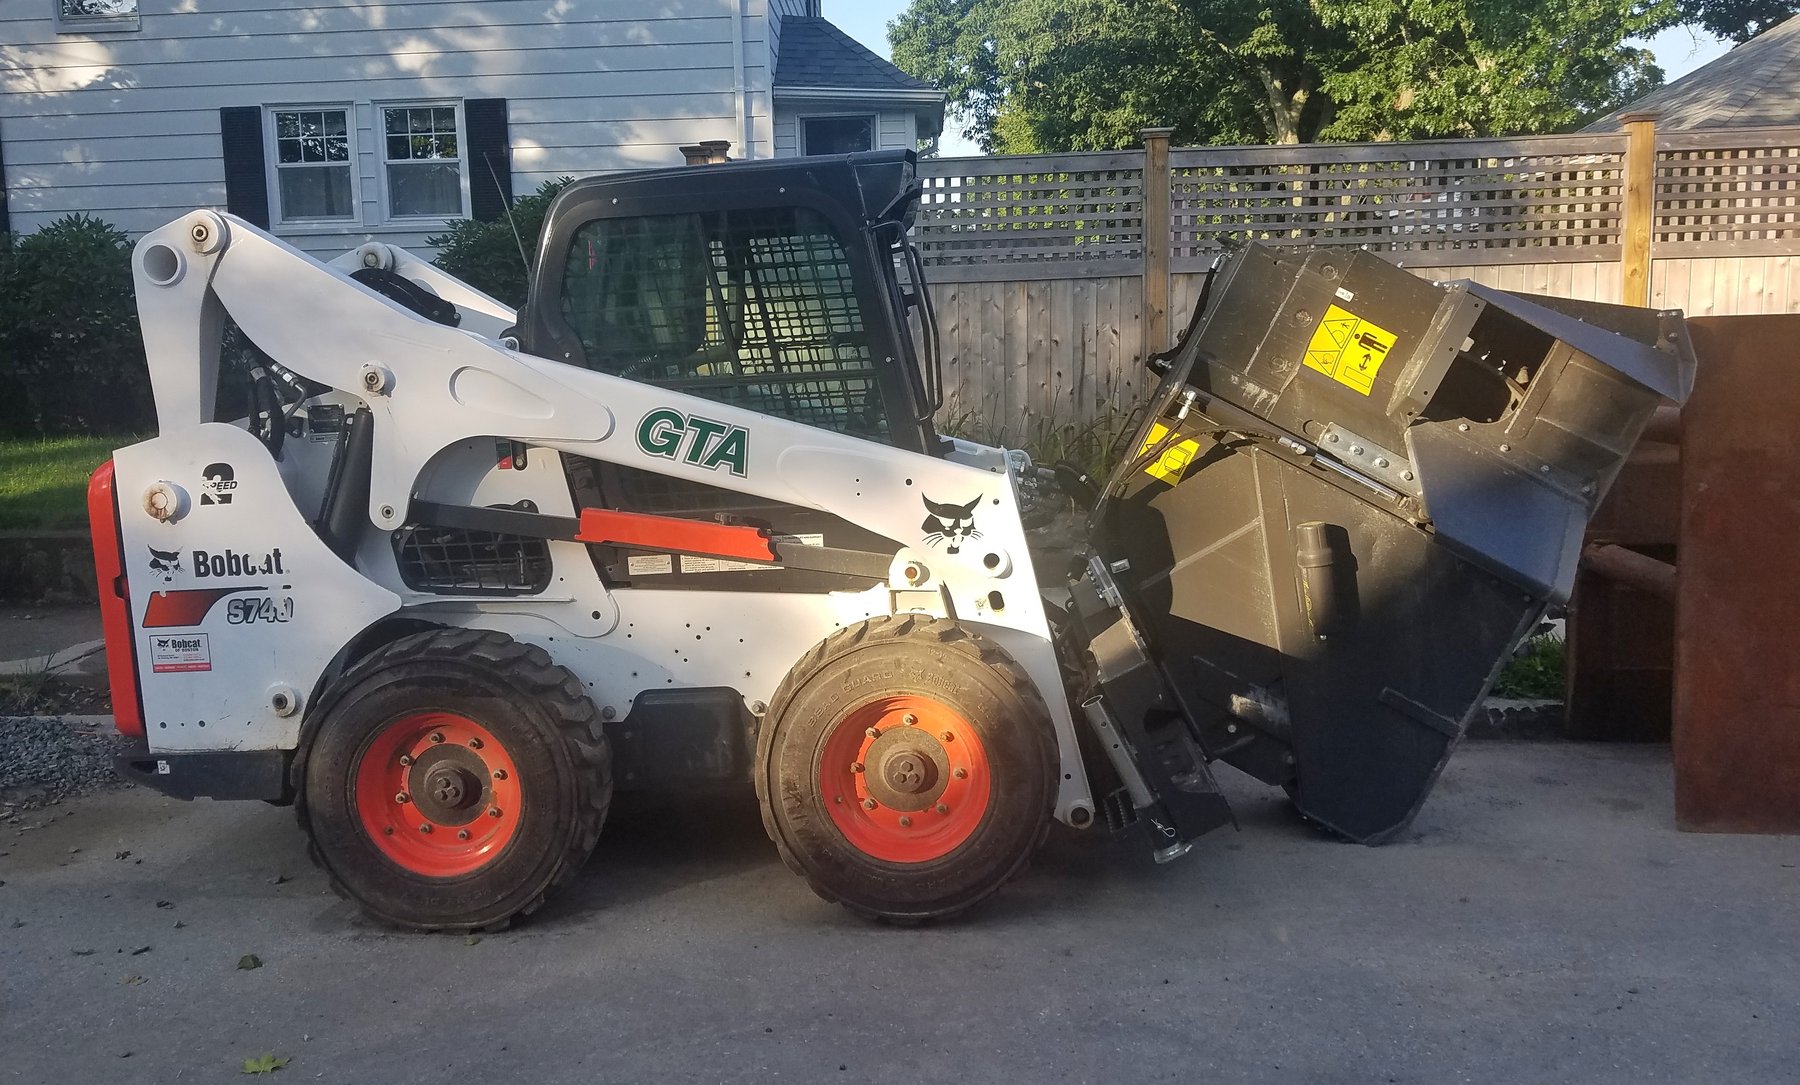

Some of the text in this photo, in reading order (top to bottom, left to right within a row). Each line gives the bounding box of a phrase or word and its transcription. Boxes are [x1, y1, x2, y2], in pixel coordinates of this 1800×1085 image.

[635, 407, 750, 479] GTA
[200, 462, 235, 505] 2
[171, 639, 201, 649] Bobcat
